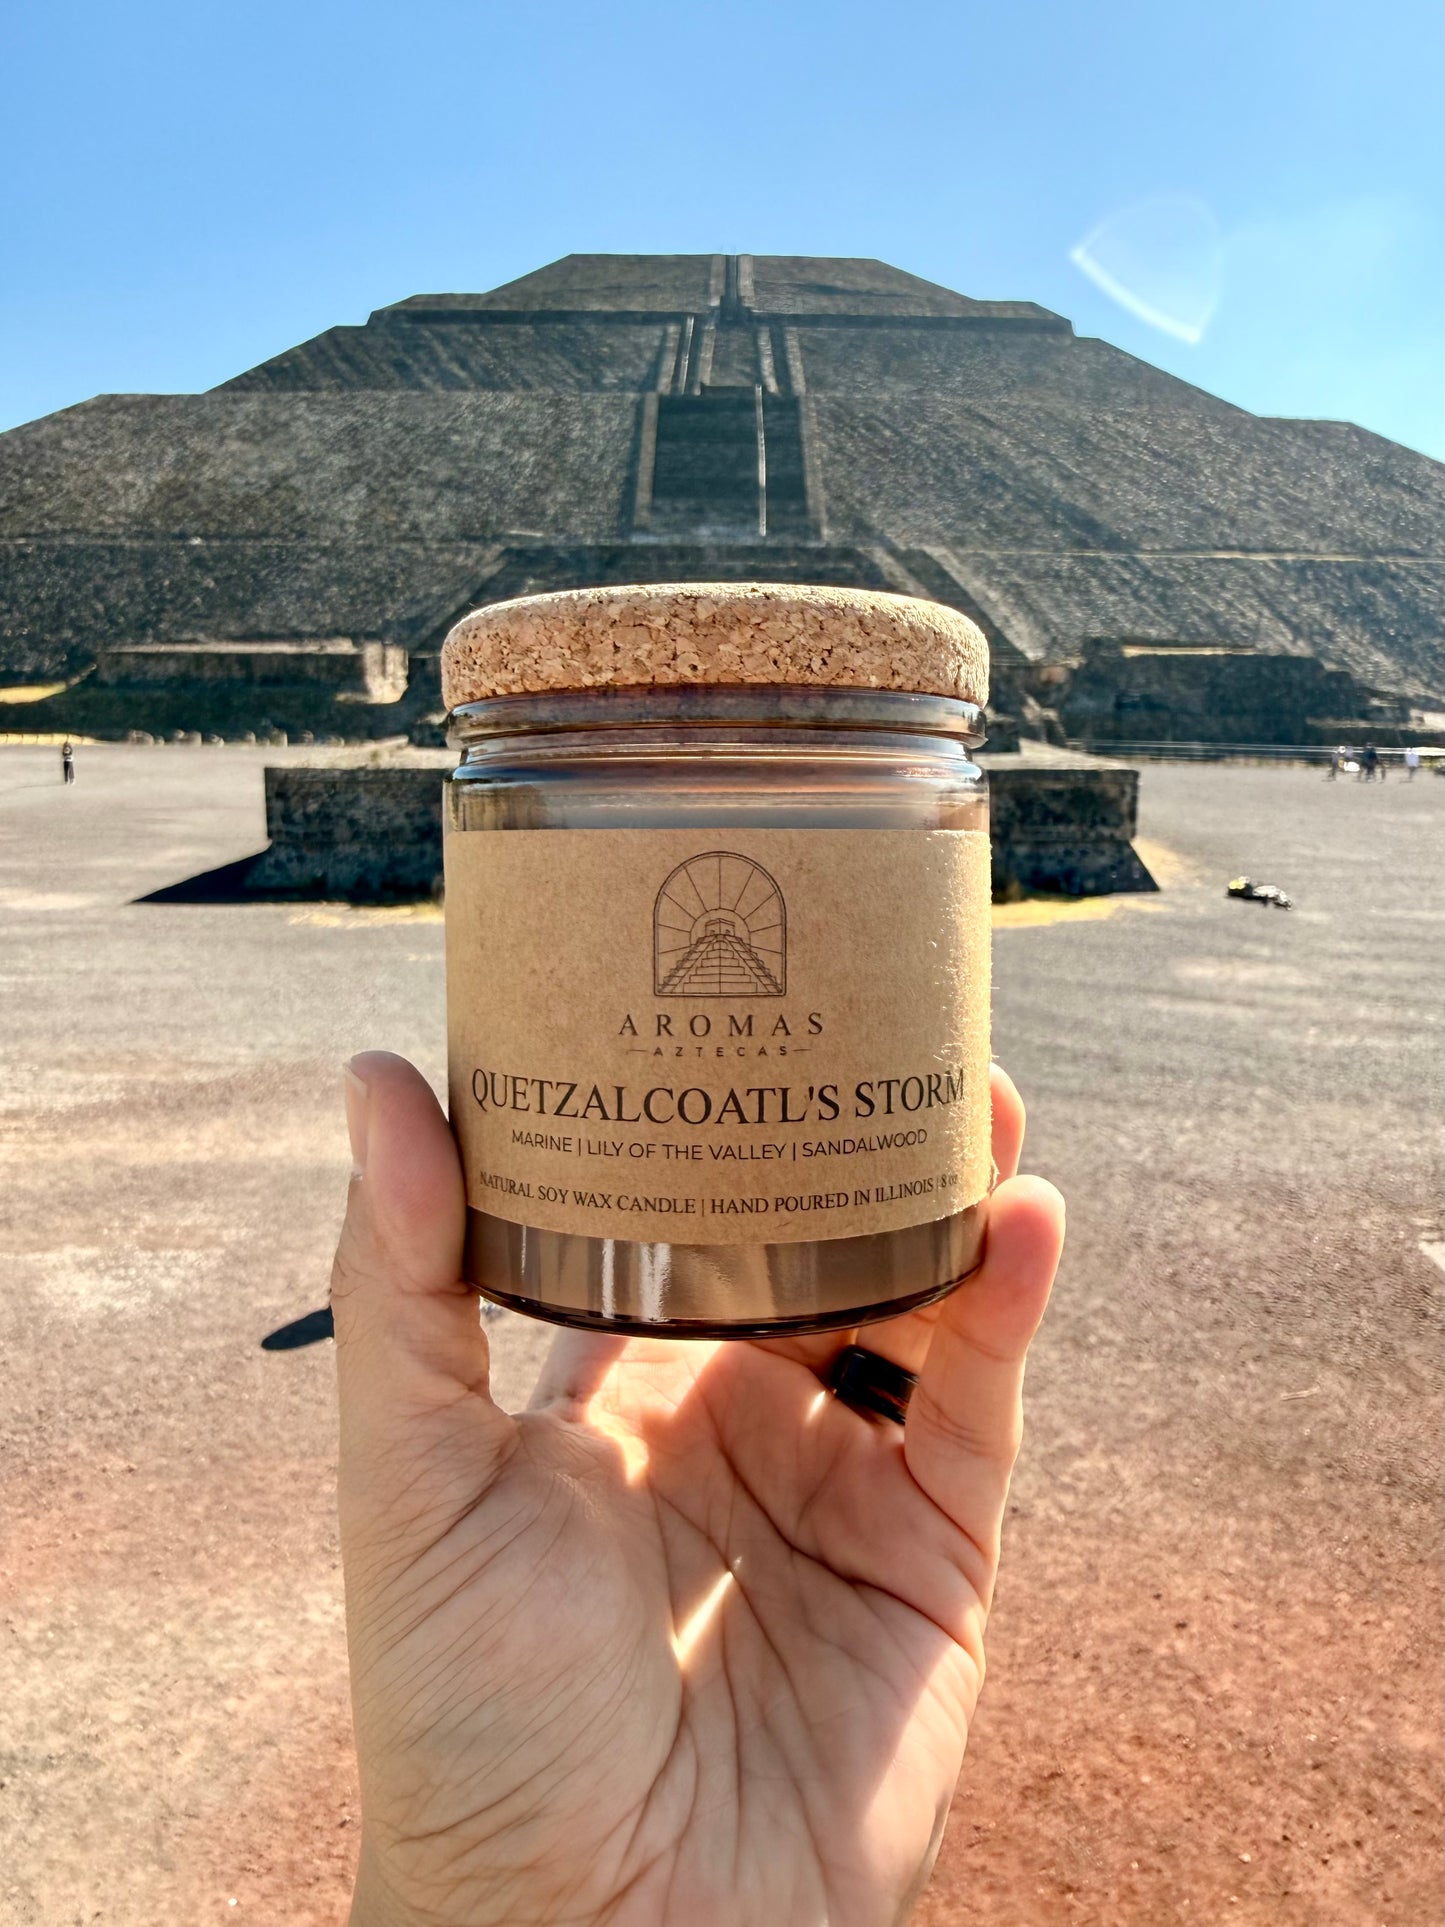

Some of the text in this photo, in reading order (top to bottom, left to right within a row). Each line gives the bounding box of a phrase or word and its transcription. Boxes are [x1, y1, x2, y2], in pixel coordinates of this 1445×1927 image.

[618, 1012, 824, 1037] AROMAS
[653, 1045, 788, 1057] AZTECAS
[472, 1068, 964, 1125] QUETZALCOATL'S STORM
[511, 1129, 573, 1152] MARINE
[587, 1140, 624, 1157] LILY
[628, 1142, 656, 1158] OF
[661, 1143, 704, 1160] THE
[708, 1143, 787, 1161] VALLEY
[802, 1128, 928, 1158] SANDALWOOD
[479, 1170, 535, 1199] NATURAL
[537, 1185, 569, 1205] SOY
[572, 1190, 613, 1209] WAX
[616, 1194, 697, 1214] CANDLE
[711, 1198, 769, 1214] HAND
[774, 1192, 850, 1213] POURED
[854, 1189, 871, 1206] IN
[875, 1177, 934, 1203] ILLINOIS
[940, 1173, 947, 1188] 8
